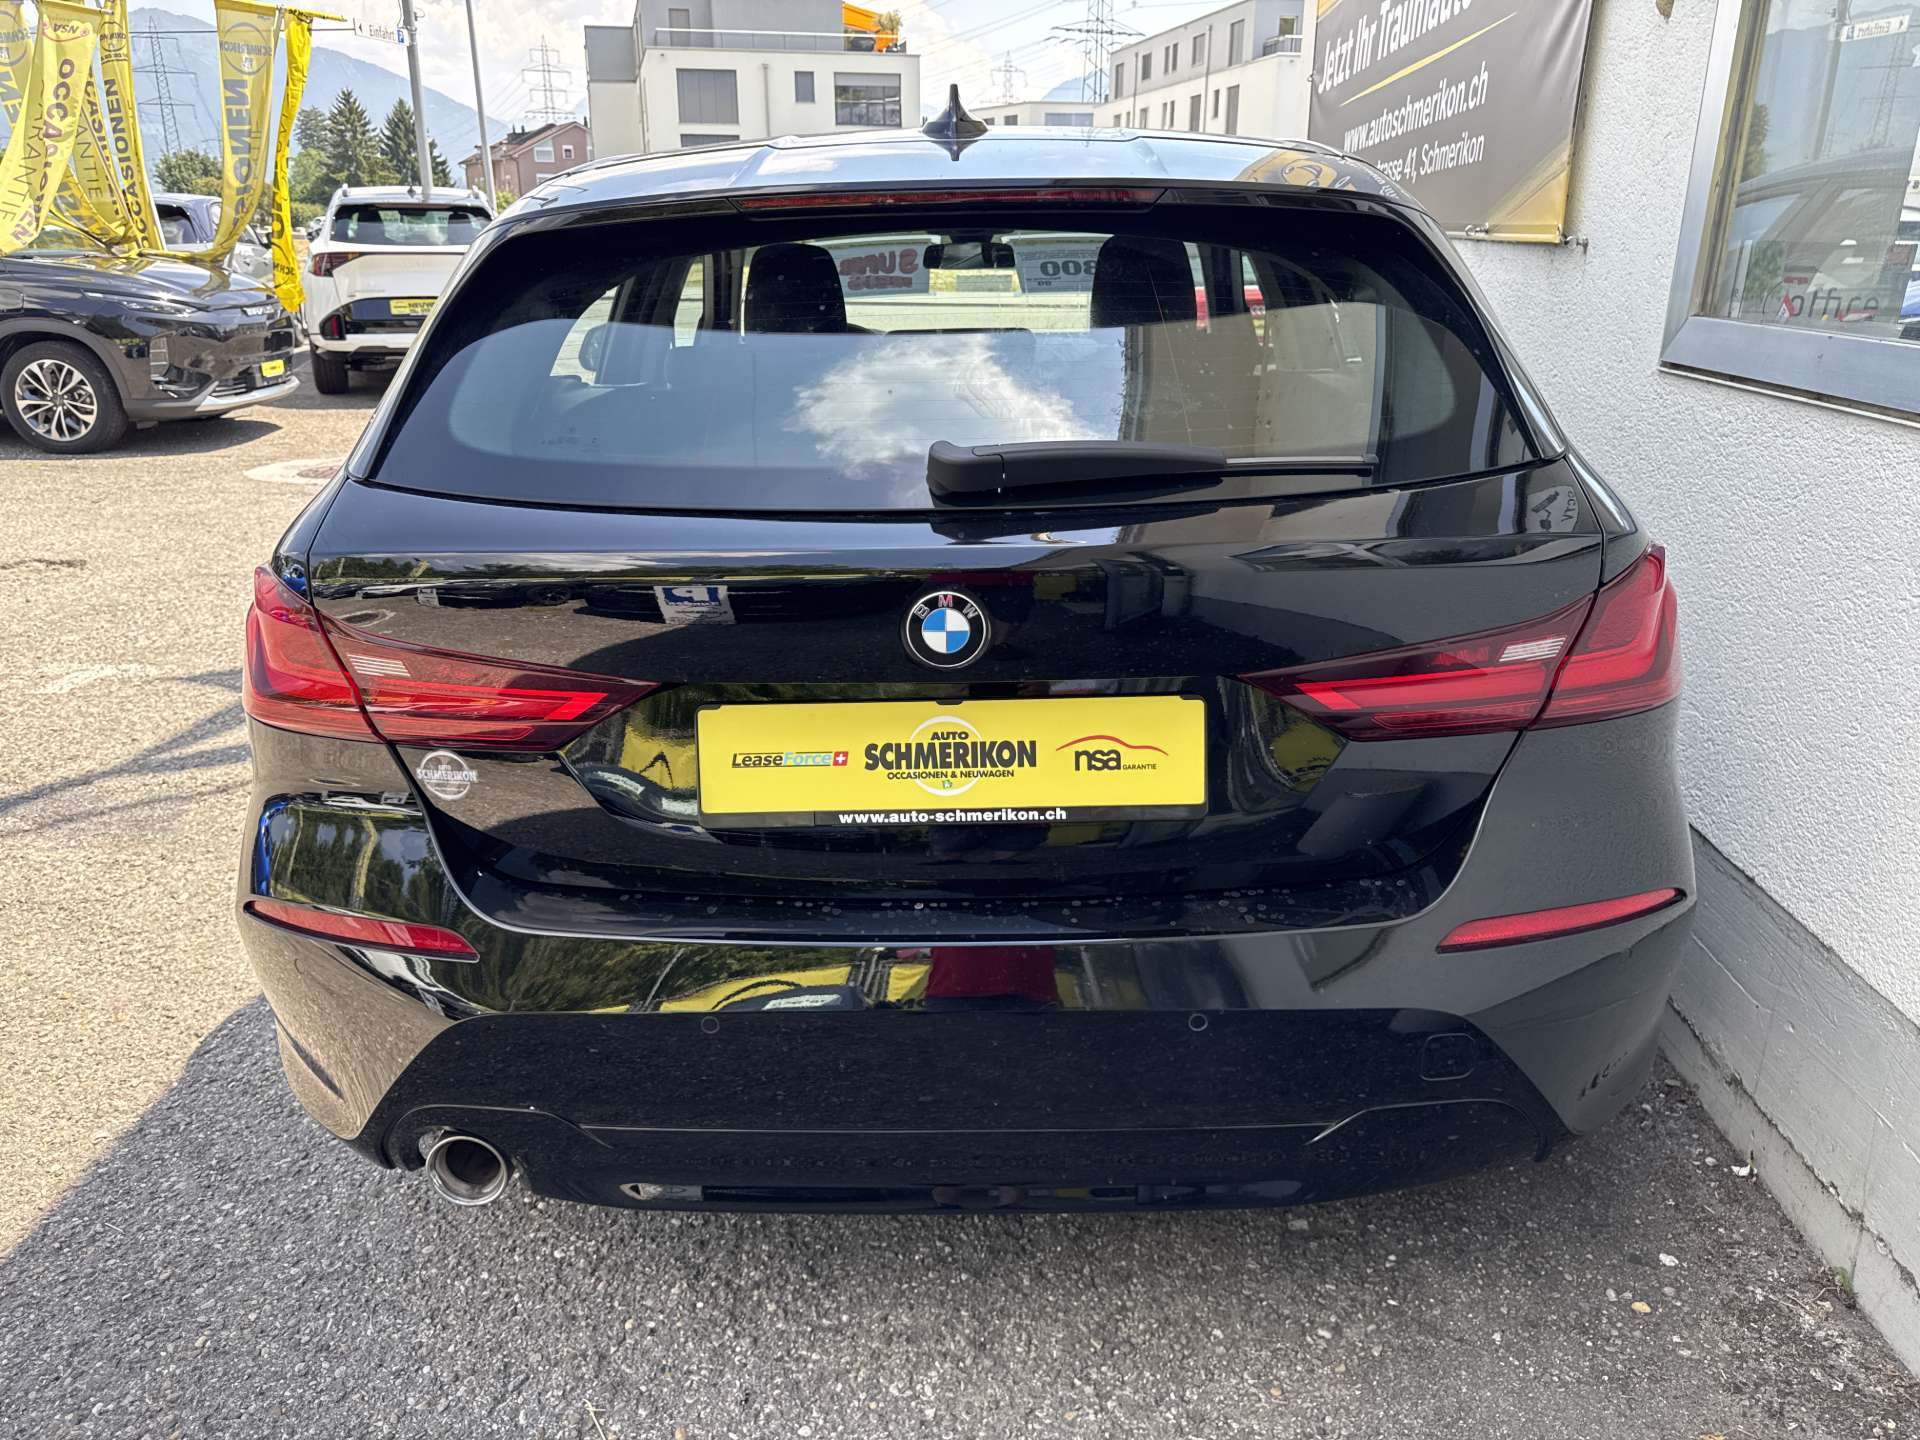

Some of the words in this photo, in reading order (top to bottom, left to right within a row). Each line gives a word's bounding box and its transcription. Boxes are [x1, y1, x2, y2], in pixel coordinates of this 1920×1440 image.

[1317, 34, 1352, 95] Jetzt
[1352, 17, 1376, 75] Ihr
[1377, 0, 1472, 61] Traumau
[1343, 61, 1489, 153] www.autoschmerikon.ch
[1420, 131, 1485, 175] Schmerikon
[914, 594, 979, 619] BMW
[930, 731, 969, 741] AUTO
[731, 752, 832, 768] LeaseForce
[863, 740, 1037, 772] SCHMERIKON
[1074, 748, 1122, 772] nsa
[1122, 763, 1157, 771] GARANTIE
[416, 768, 479, 782] SCHMERIKON
[887, 770, 949, 780] OCCASIONEN
[950, 770, 958, 779] &
[959, 768, 1015, 779] NEUWAGEN
[838, 807, 1067, 824] www.auto-schmerikon.ch
